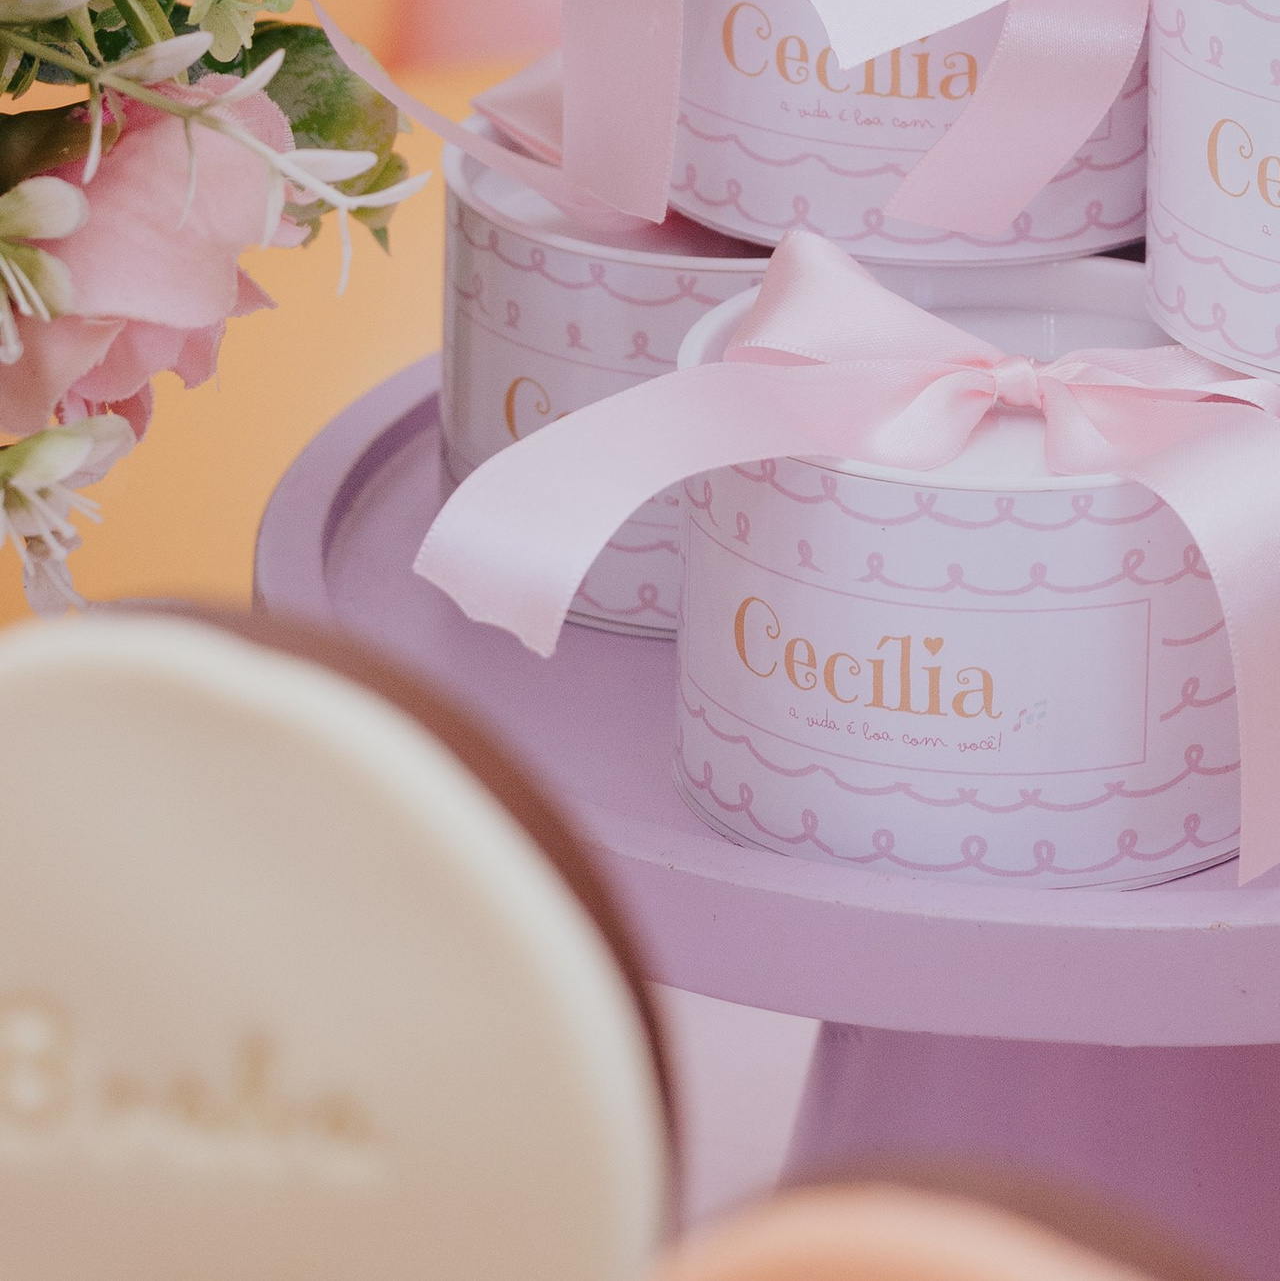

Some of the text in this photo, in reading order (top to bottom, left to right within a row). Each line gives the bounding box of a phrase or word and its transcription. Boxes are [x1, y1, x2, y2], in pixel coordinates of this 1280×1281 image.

[780, 101, 790, 112] a
[853, 108, 884, 126] boa
[892, 117, 935, 129] com
[1261, 224, 1272, 236] a
[734, 597, 1003, 719] Cecília
[788, 707, 1003, 752] a vida é boa com você!
